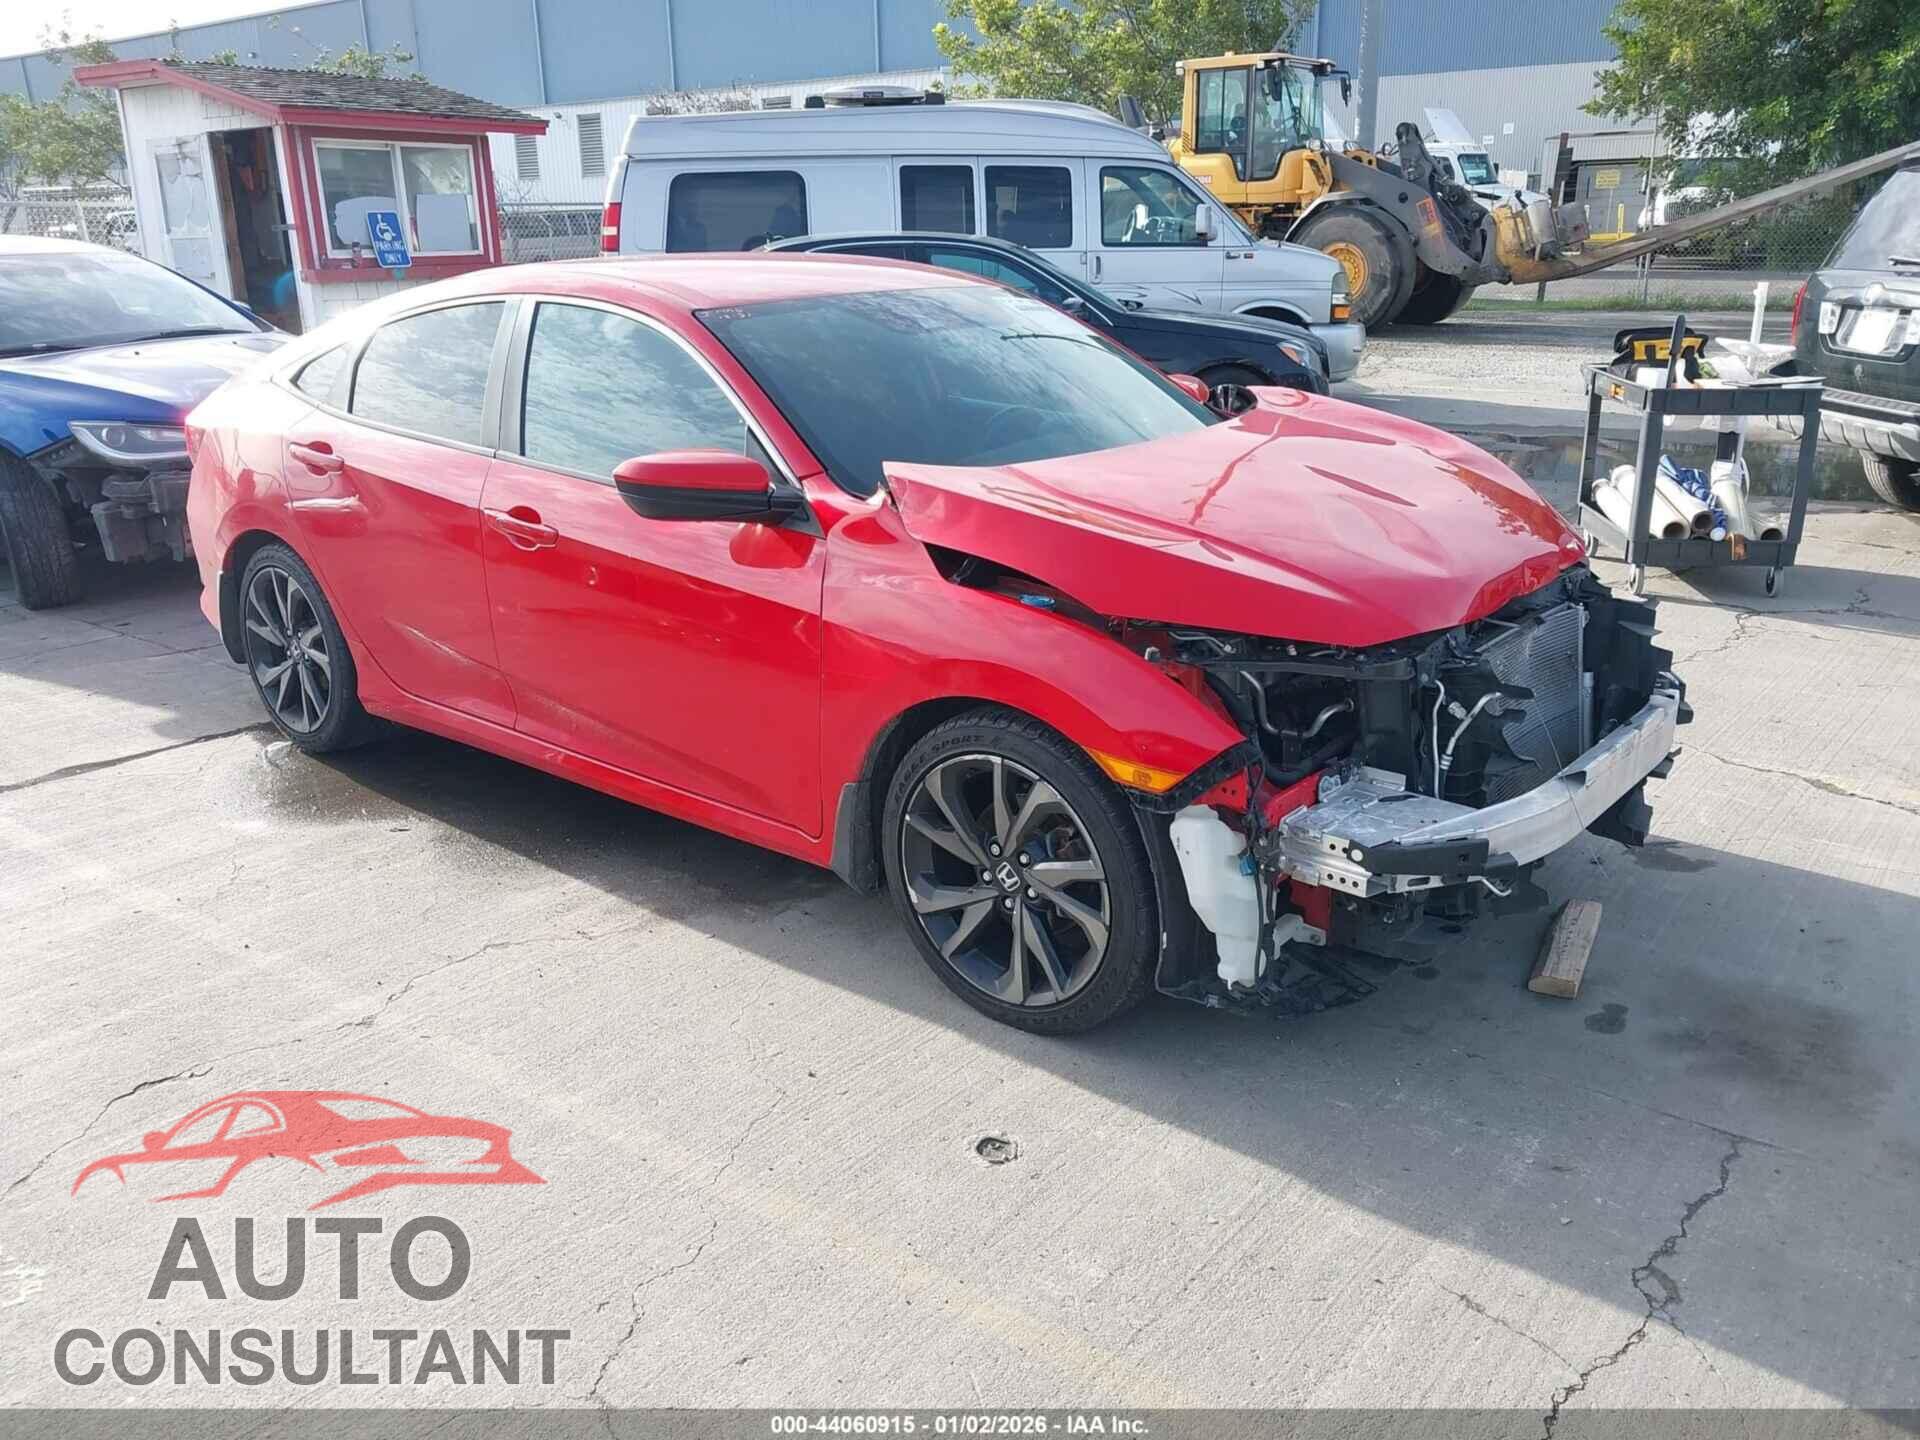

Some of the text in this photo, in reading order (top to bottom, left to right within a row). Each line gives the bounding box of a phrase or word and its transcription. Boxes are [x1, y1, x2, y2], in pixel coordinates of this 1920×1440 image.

[375, 240, 406, 251] PARKING
[384, 252, 403, 264] ONLY
[931, 735, 984, 752] SPORT
